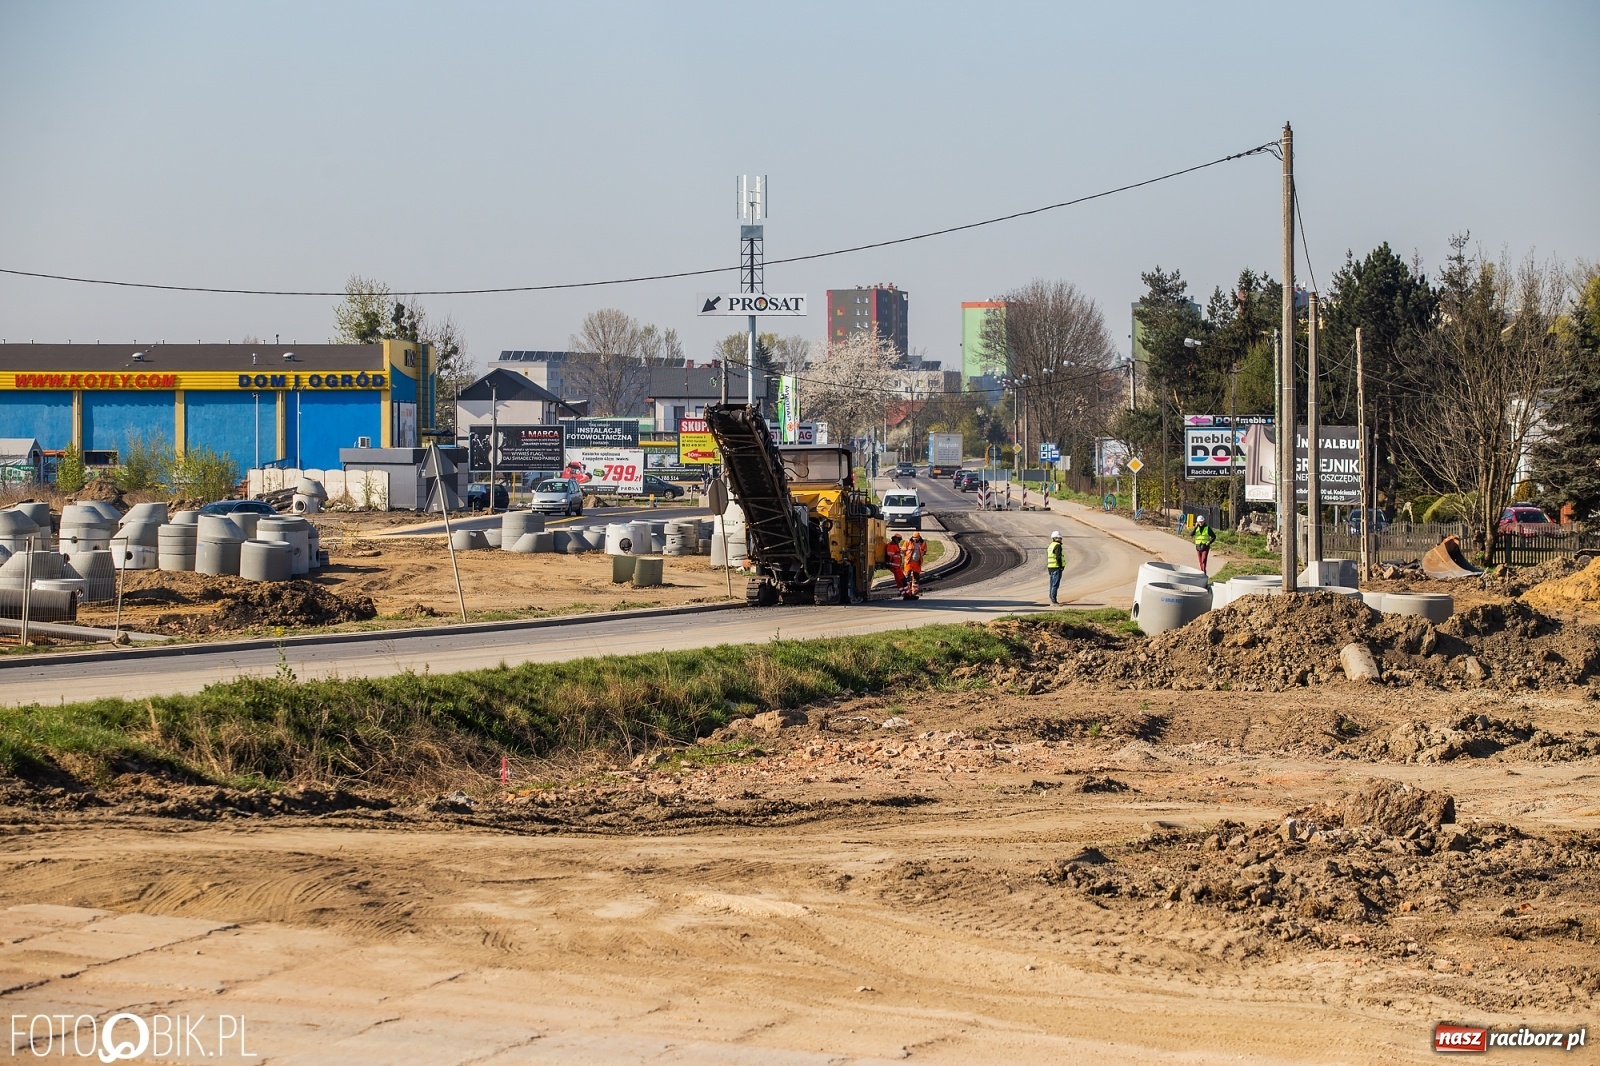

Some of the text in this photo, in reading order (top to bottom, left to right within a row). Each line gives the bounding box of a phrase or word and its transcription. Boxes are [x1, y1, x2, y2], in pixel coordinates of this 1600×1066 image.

[728, 297, 804, 311] PROSAT
[14, 374, 176, 388] WWW.KOTLY.COM
[238, 374, 286, 387] DOM
[308, 371, 385, 387] OGRÓD
[1191, 434, 1231, 443] meble
